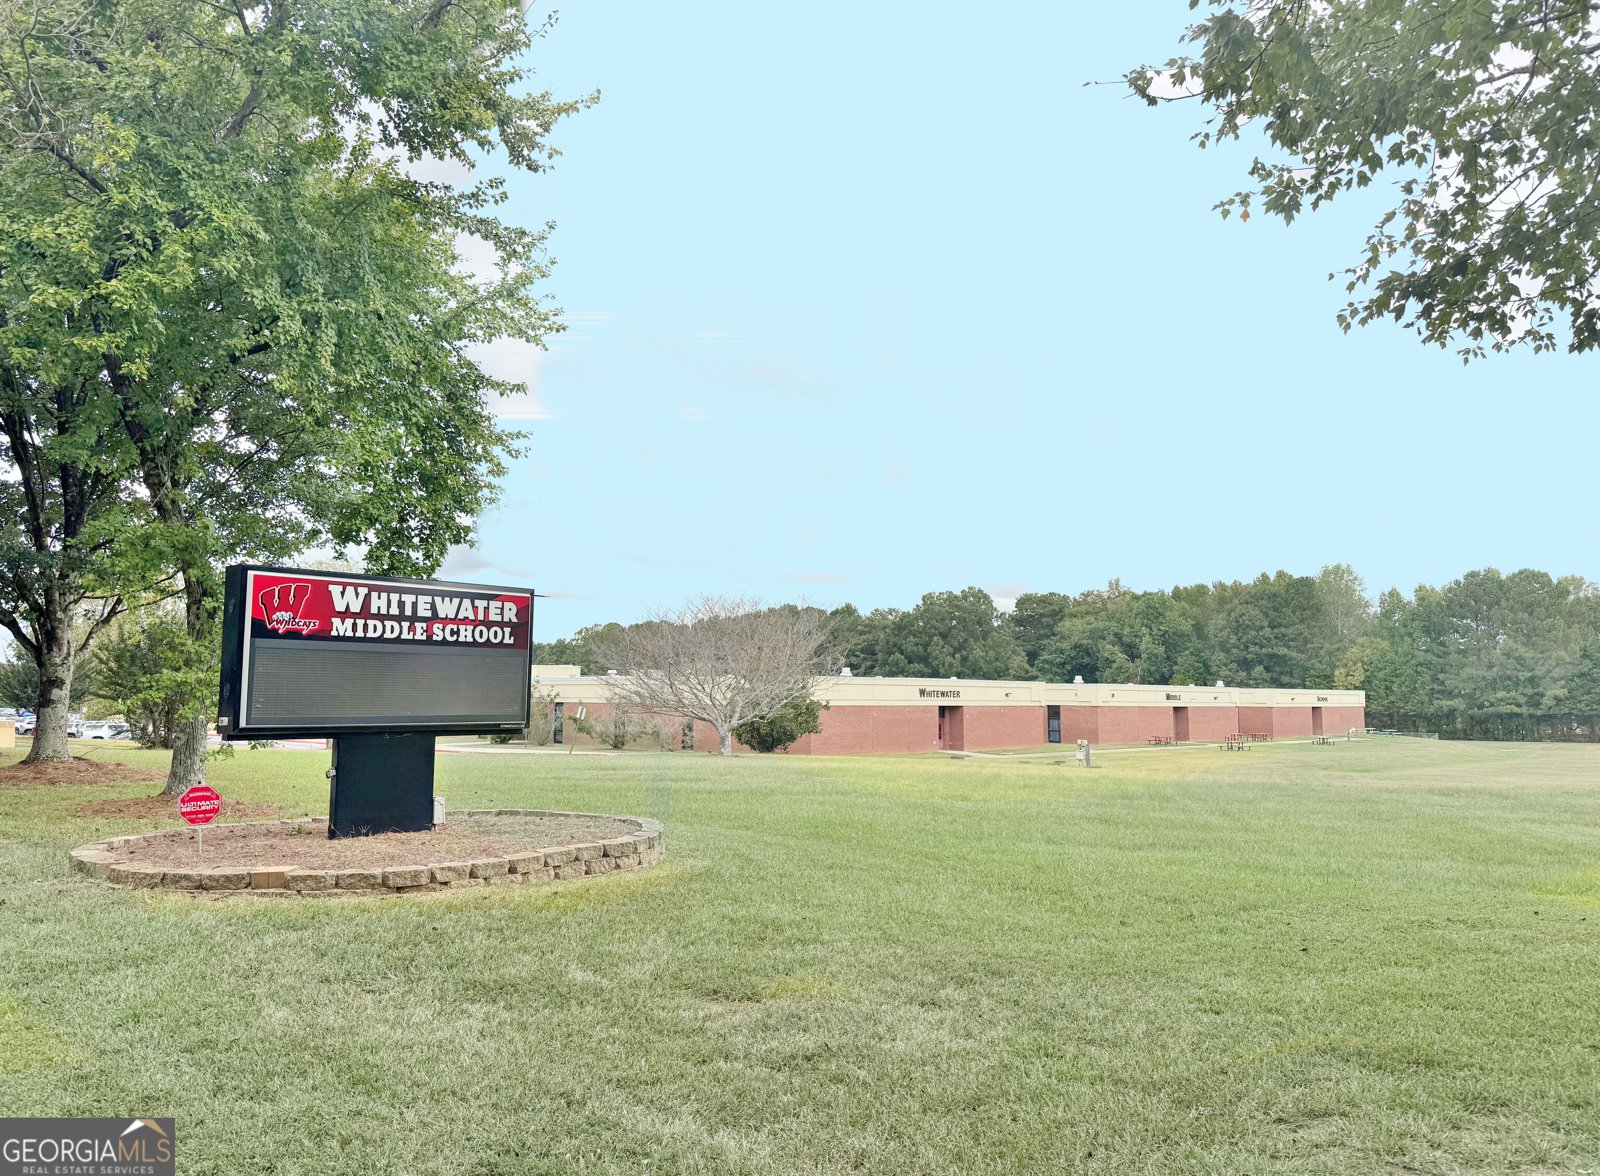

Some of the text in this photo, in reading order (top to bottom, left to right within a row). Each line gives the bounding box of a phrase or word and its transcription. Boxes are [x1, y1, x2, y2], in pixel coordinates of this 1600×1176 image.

[328, 584, 518, 622] WHITEWATER
[330, 618, 514, 644] MIDDLE SCHOOL
[919, 688, 960, 698] WHITEWATER
[181, 804, 219, 812] SECURITY
